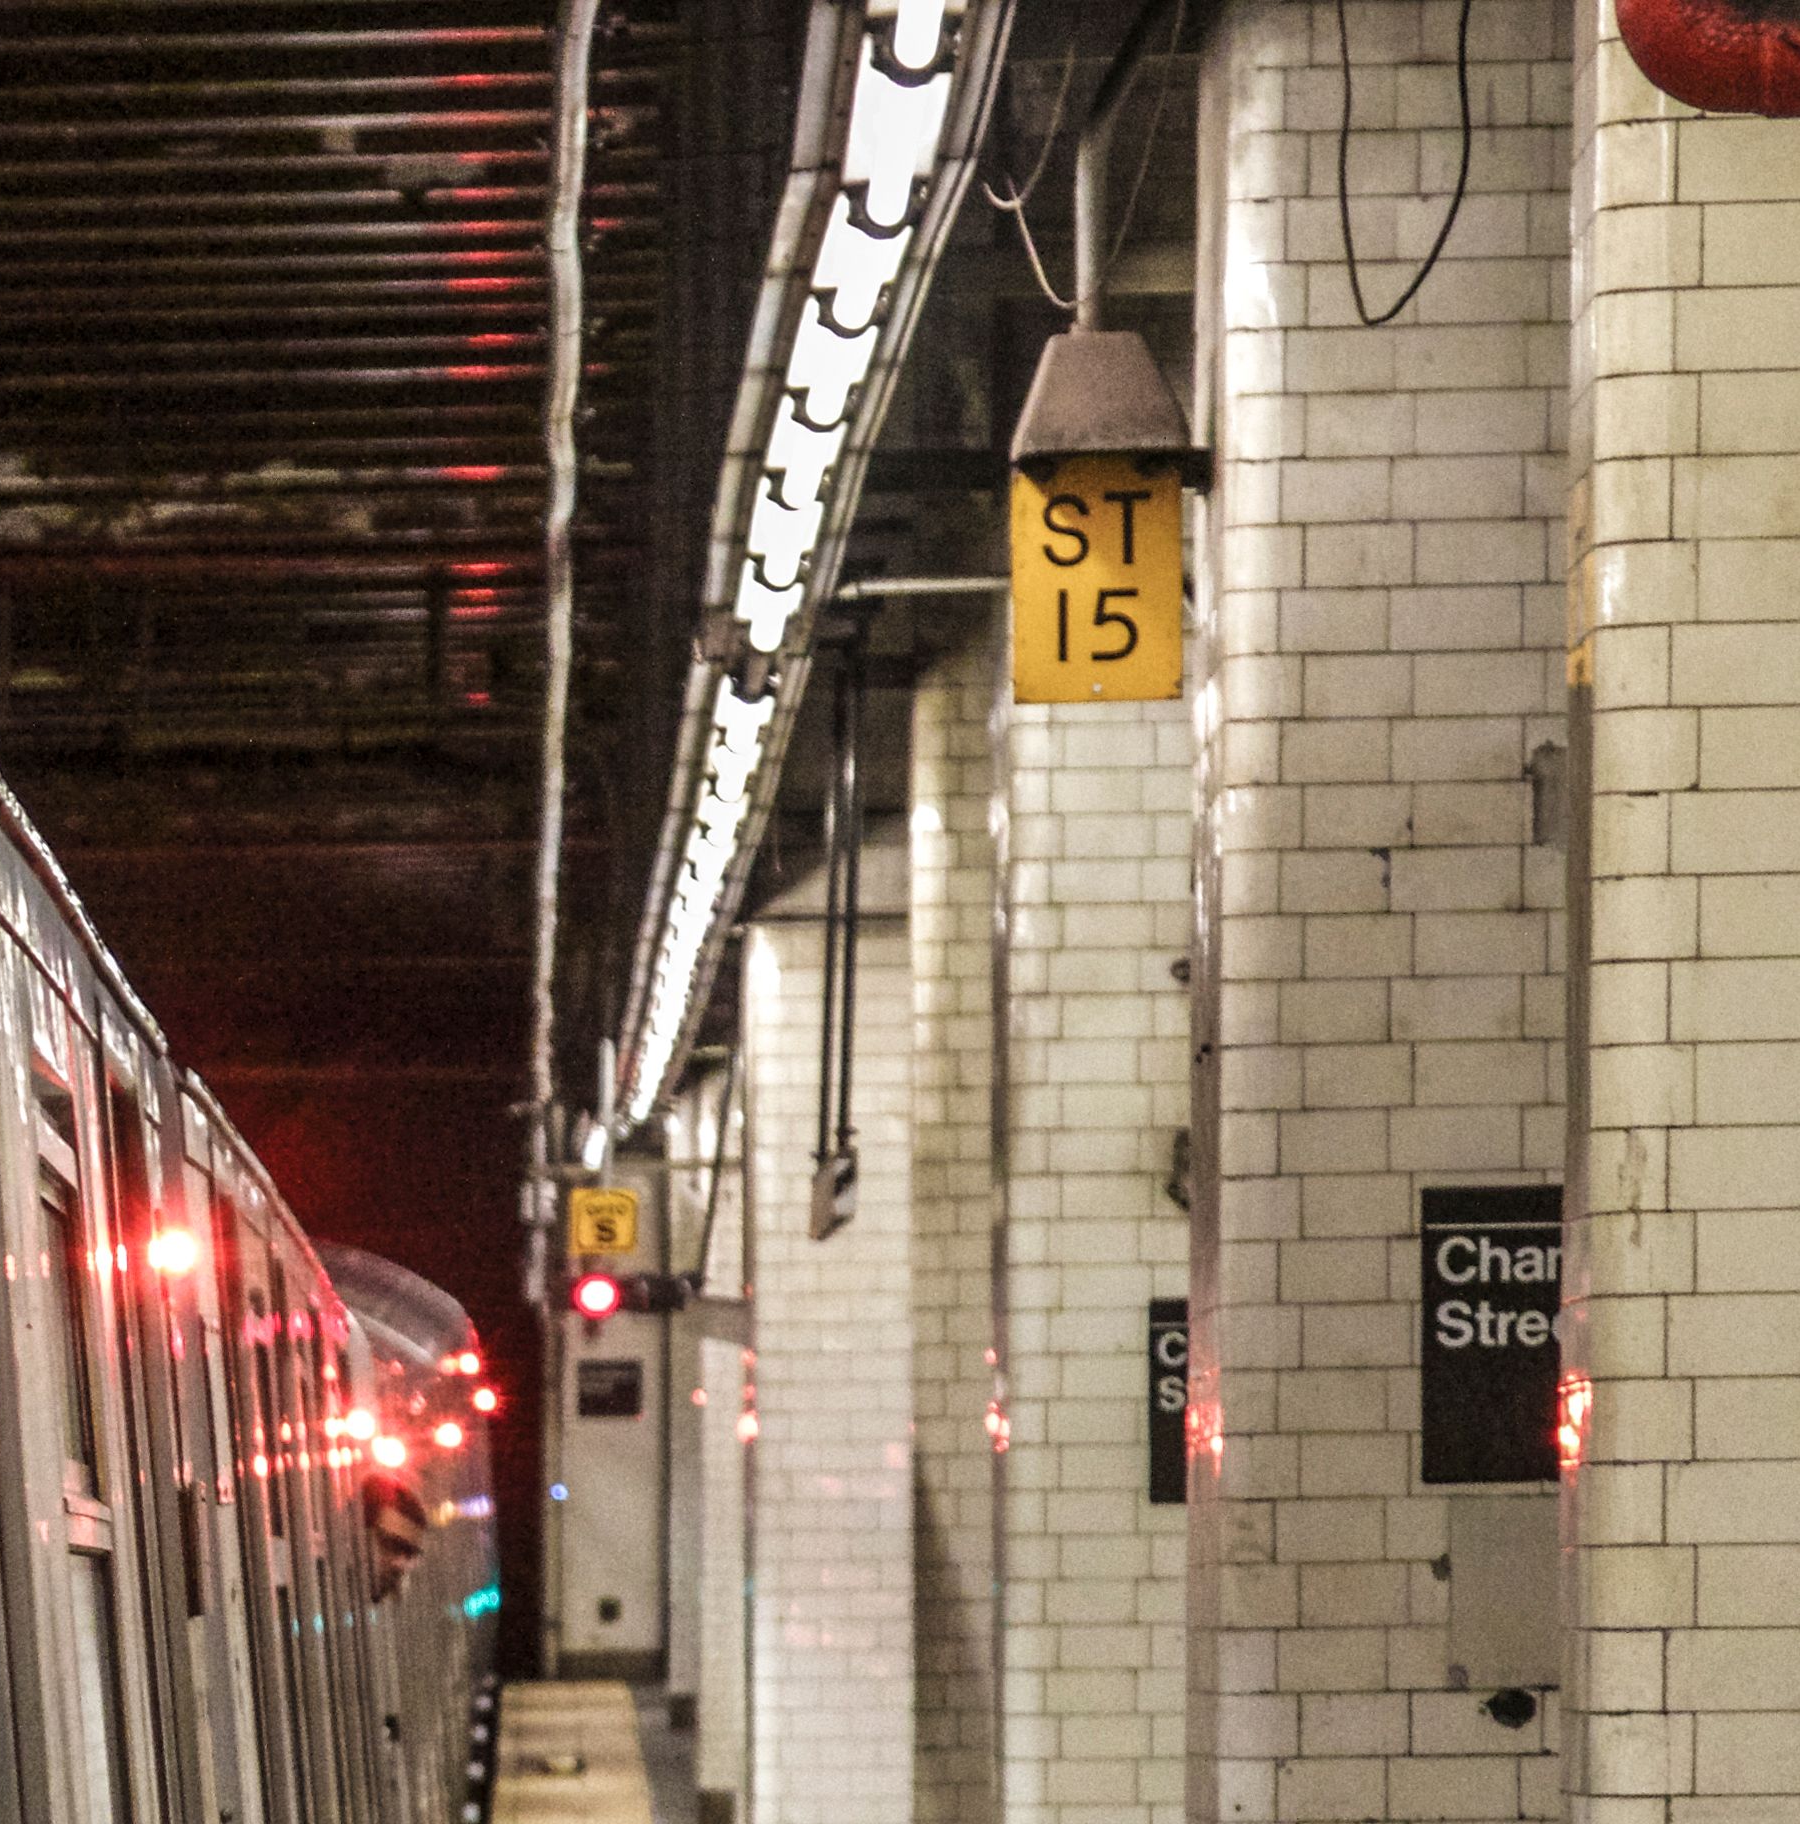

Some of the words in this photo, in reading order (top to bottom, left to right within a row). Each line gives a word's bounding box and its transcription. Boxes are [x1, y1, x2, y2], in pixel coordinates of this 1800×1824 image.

[1042, 490, 1151, 567] ST
[1058, 589, 1140, 662] 15
[1435, 1299, 1562, 1348] Stre
